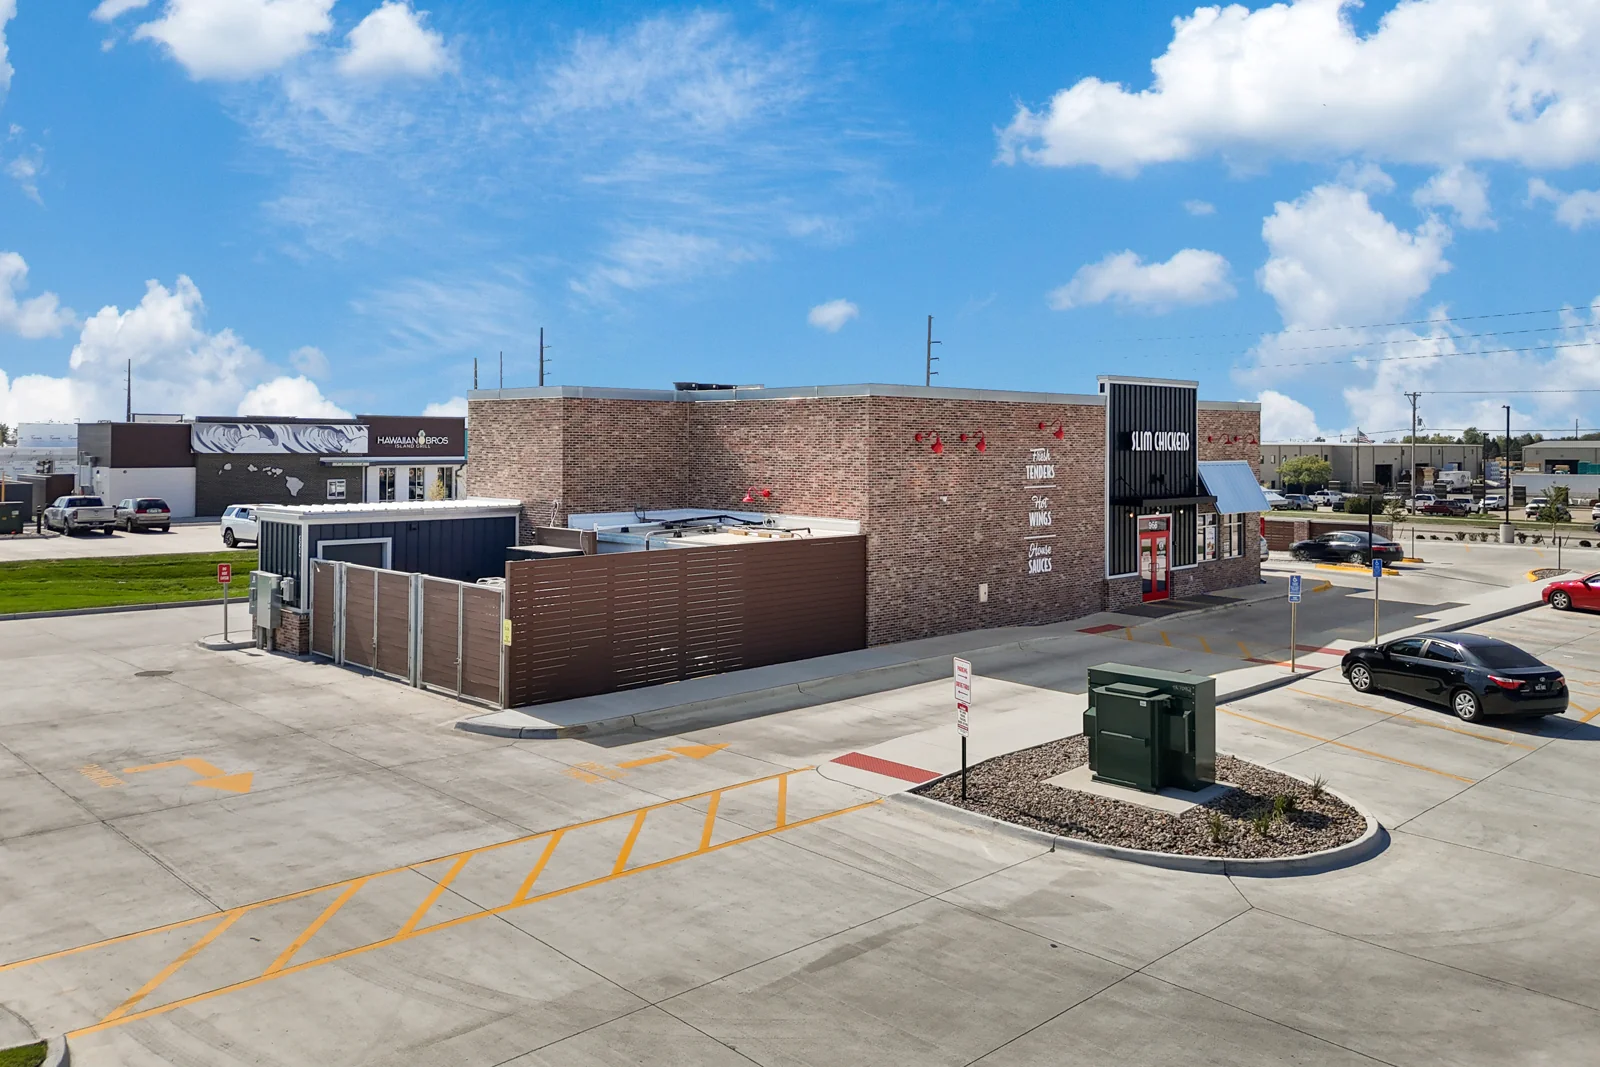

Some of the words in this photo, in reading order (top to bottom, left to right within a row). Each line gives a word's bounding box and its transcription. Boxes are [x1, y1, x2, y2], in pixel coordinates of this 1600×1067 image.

[377, 436, 418, 444] HAWAIIAN
[425, 436, 449, 444] BROS
[1131, 431, 1153, 451] SLIM
[1154, 431, 1190, 451] CHICKENS
[1025, 464, 1055, 480] TENDERS
[1031, 495, 1049, 510] Hot
[1028, 511, 1052, 527] WINGS
[1028, 542, 1052, 558] House
[1028, 557, 1052, 575] SAUCES
